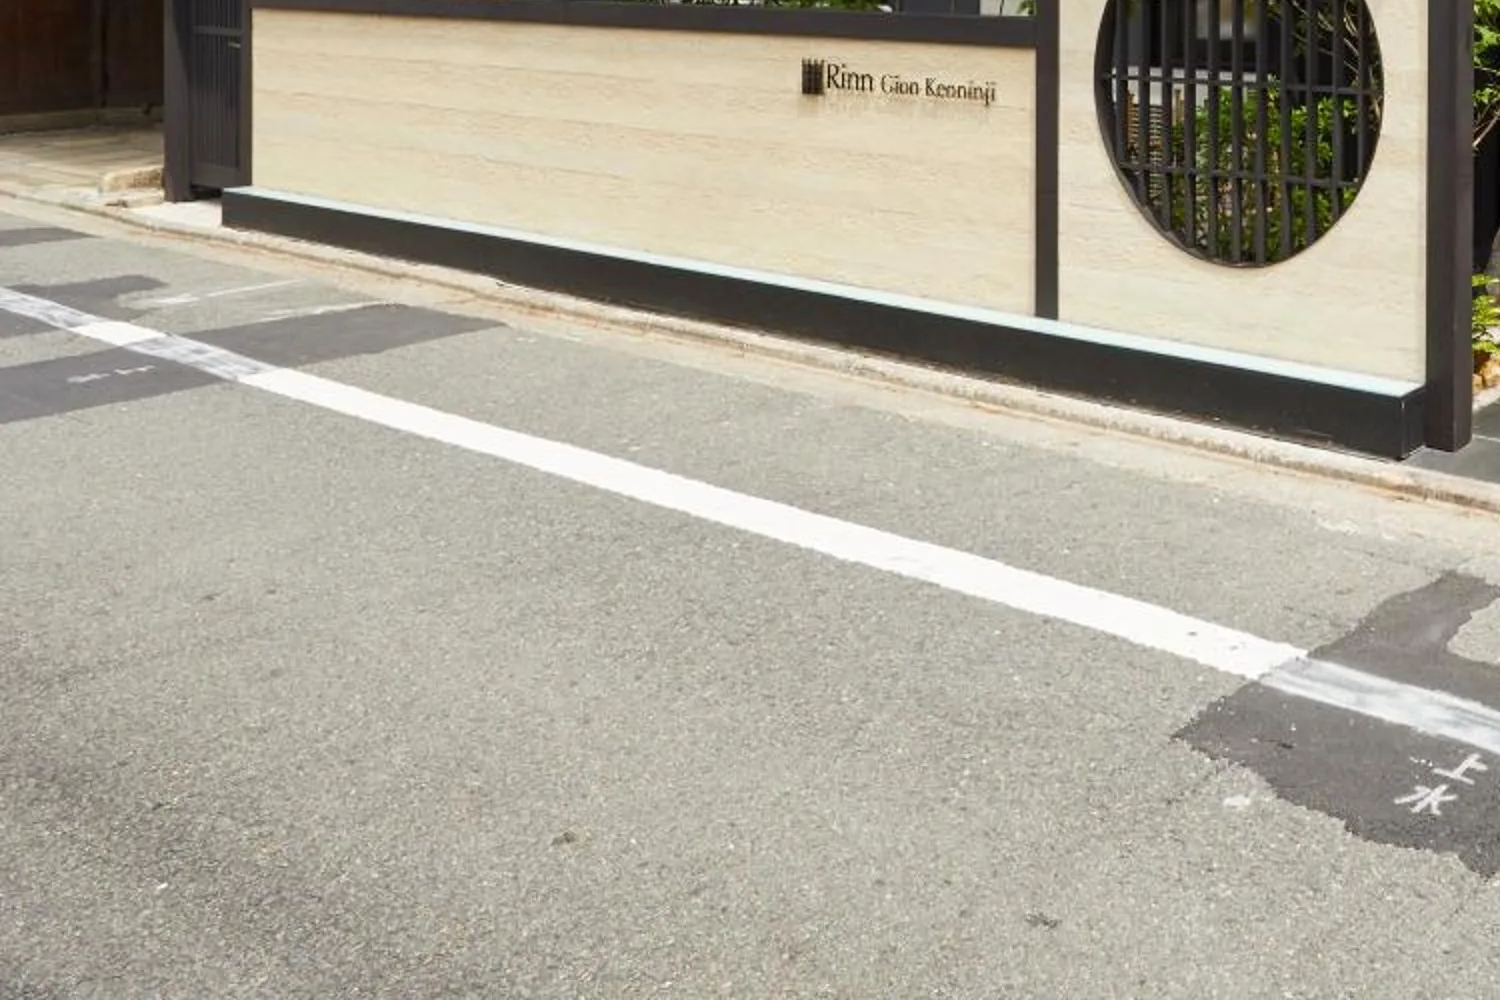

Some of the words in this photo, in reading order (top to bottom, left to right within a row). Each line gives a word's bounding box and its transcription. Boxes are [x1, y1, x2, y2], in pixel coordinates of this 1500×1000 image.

[826, 62, 873, 93] Rinn
[880, 73, 919, 96] Gion
[925, 76, 996, 107] Kenninji
